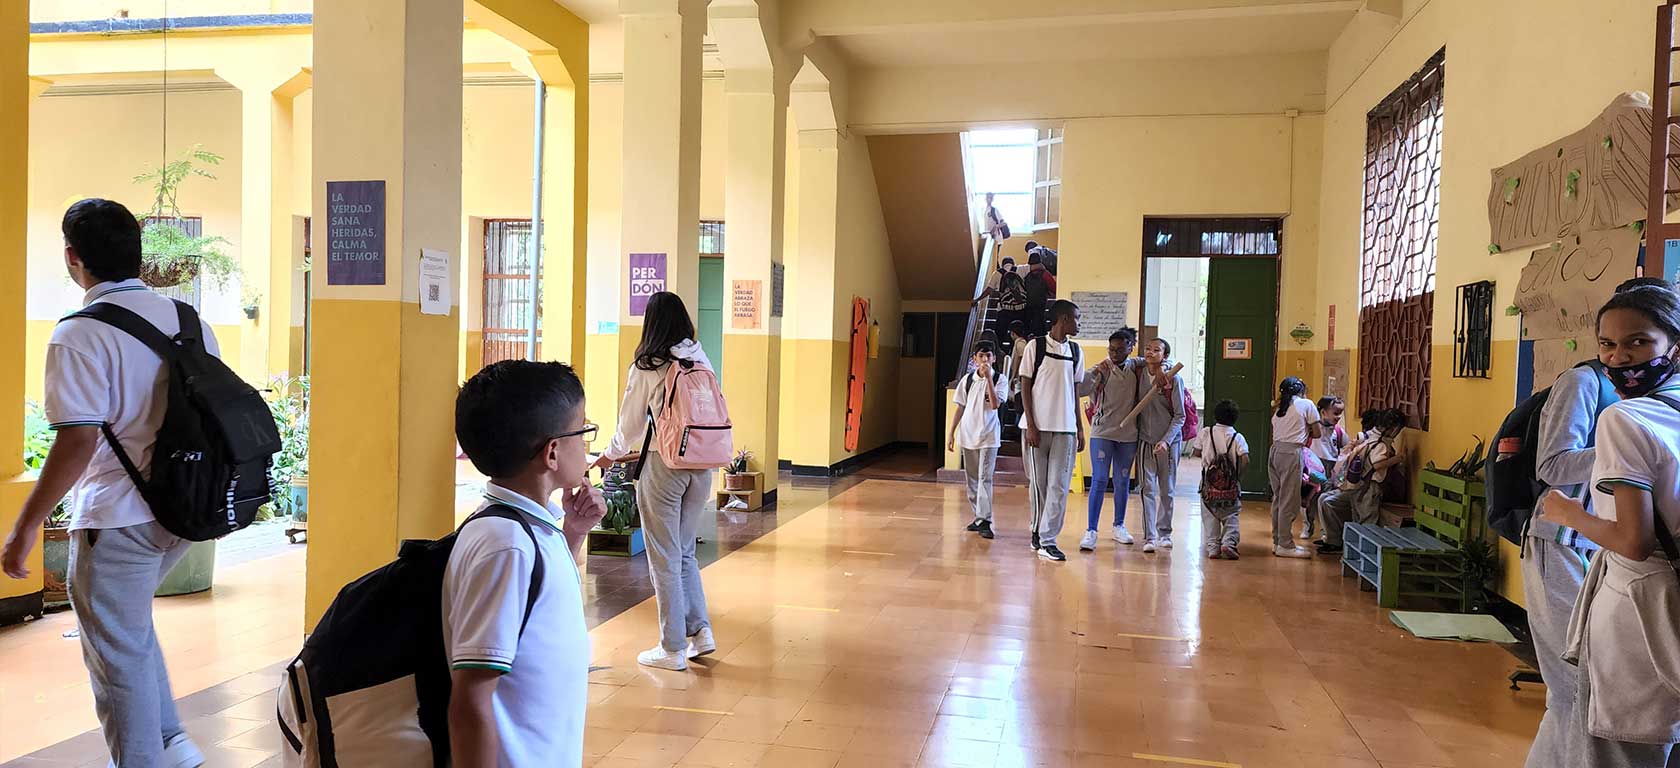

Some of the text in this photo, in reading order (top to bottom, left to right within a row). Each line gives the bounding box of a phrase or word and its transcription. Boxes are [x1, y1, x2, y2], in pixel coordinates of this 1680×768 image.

[331, 192, 344, 202] LA
[331, 204, 372, 214] VERDAD
[331, 216, 361, 226] SANA
[331, 228, 377, 239] HERIDAS,
[331, 240, 367, 250] CALMA
[331, 252, 380, 262] EL TEMOR
[632, 267, 657, 279] PER
[632, 280, 663, 295] DÓN
